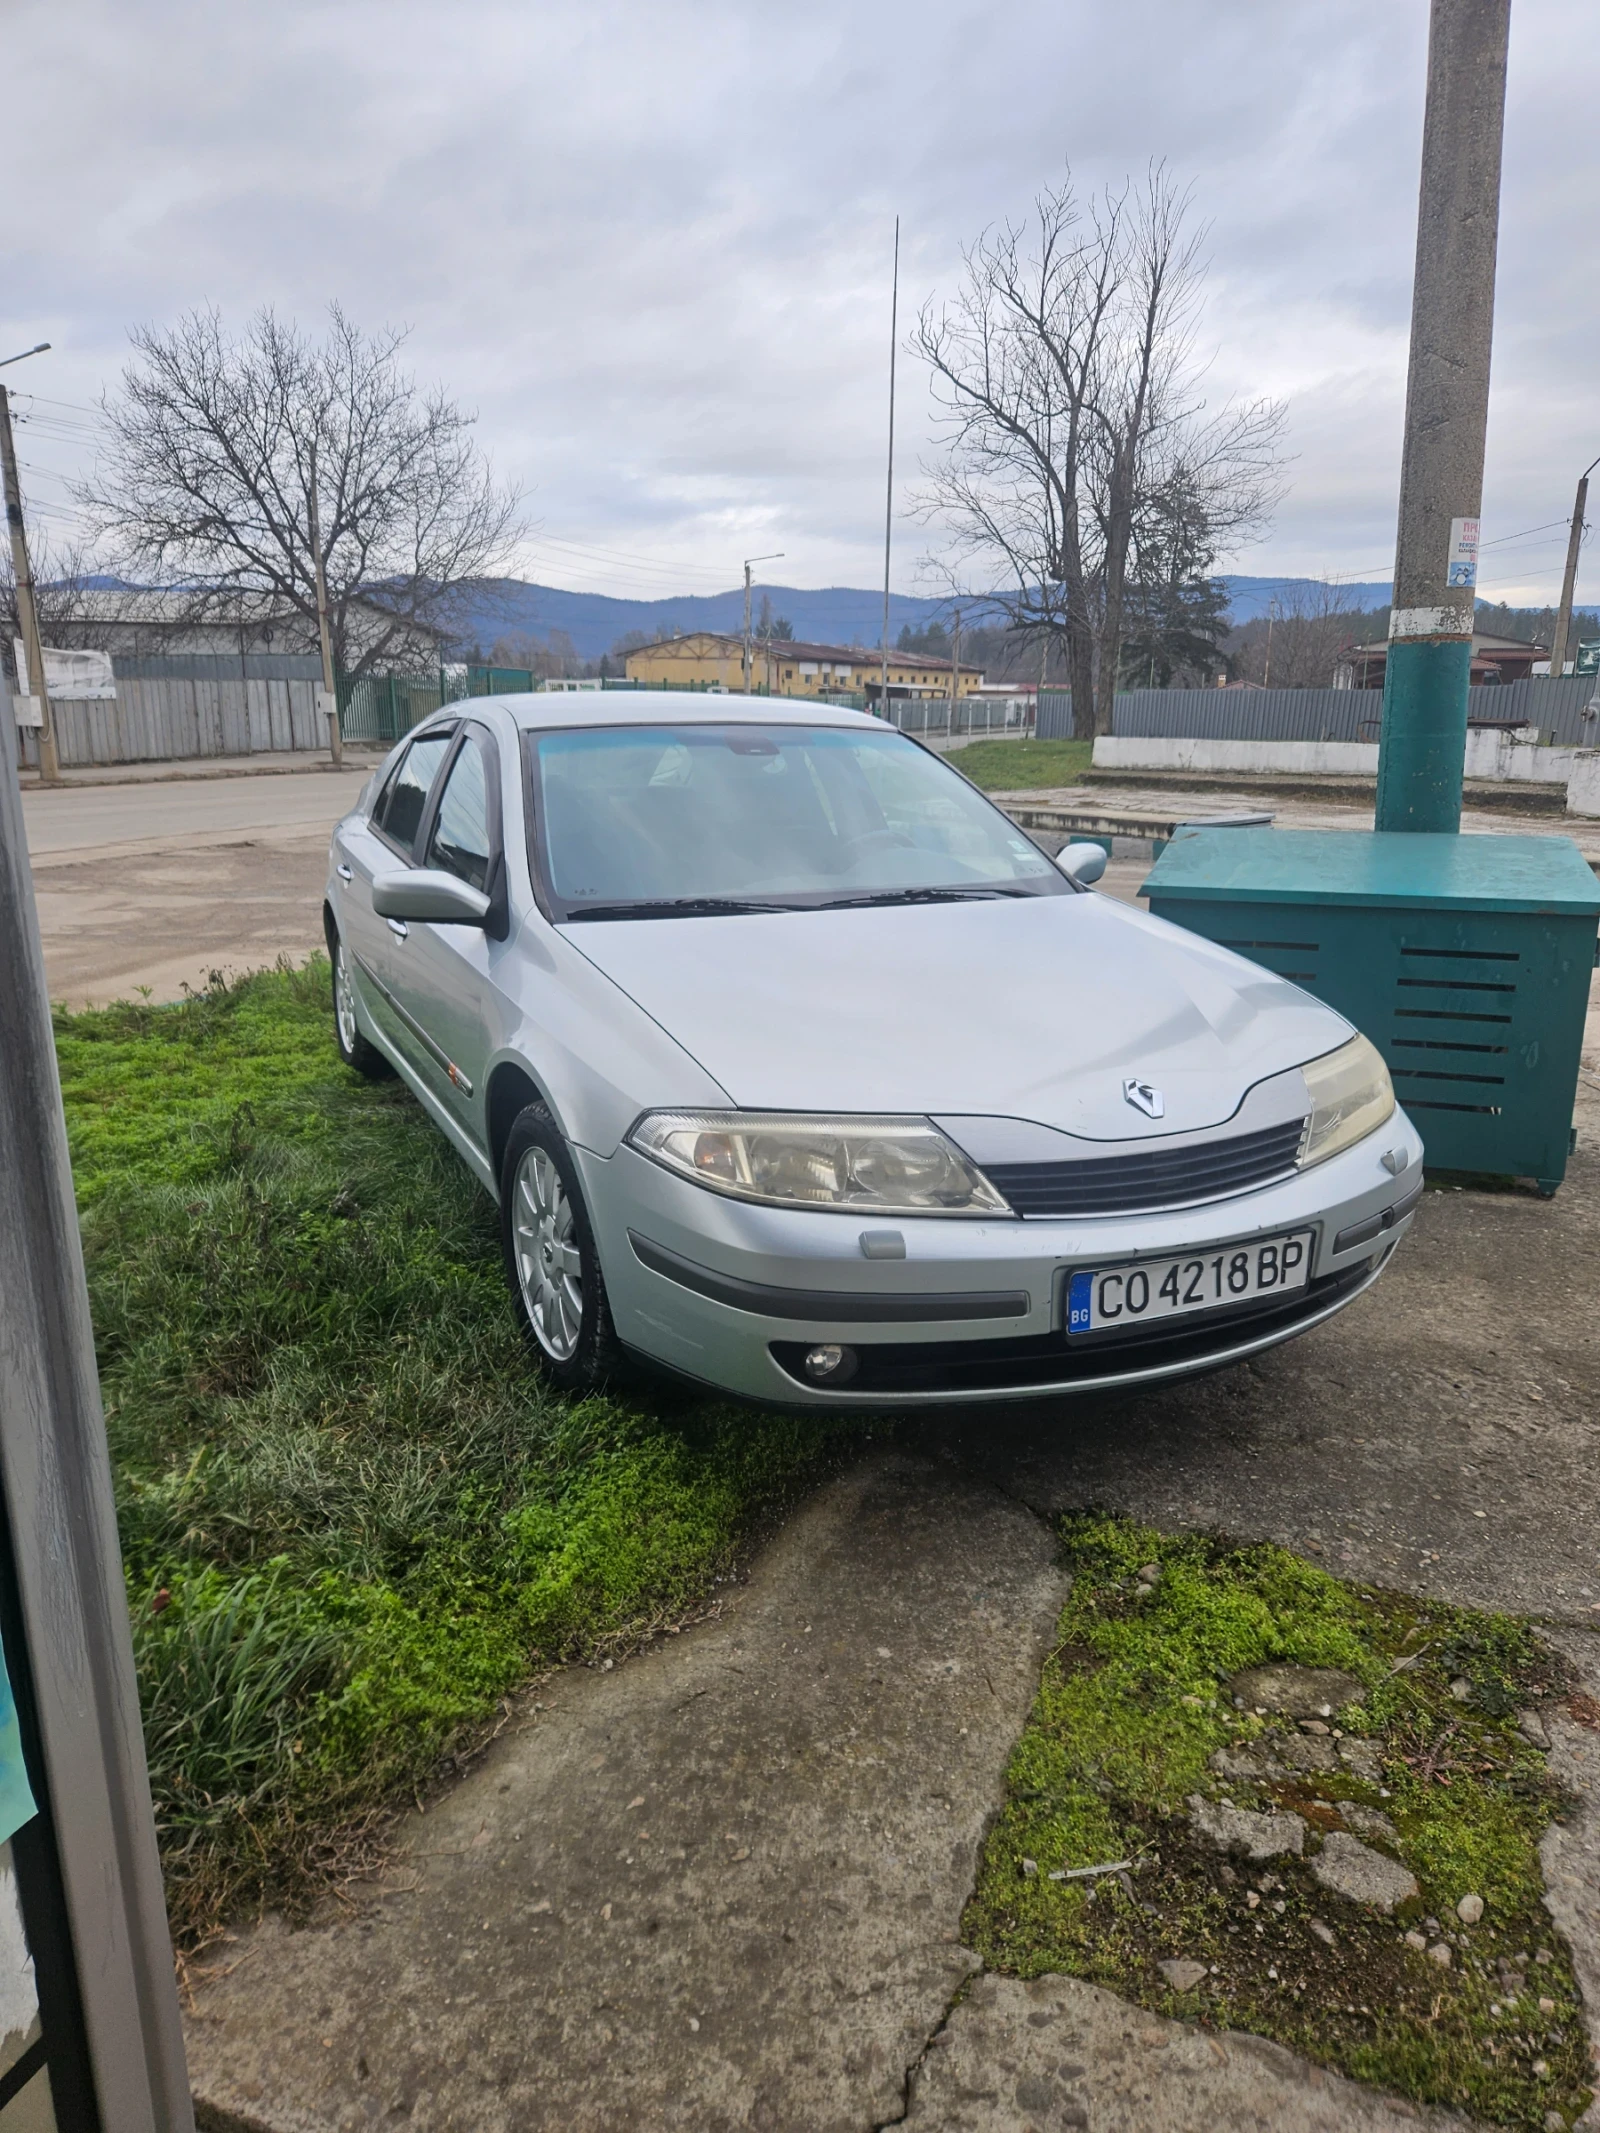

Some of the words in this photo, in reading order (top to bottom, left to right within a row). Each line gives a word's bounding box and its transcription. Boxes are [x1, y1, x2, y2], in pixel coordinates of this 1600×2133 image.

[1098, 1270, 1150, 1319] CO
[1159, 1252, 1249, 1307] 4218
[1256, 1240, 1303, 1290] BP
[1071, 1308, 1089, 1325] BG
